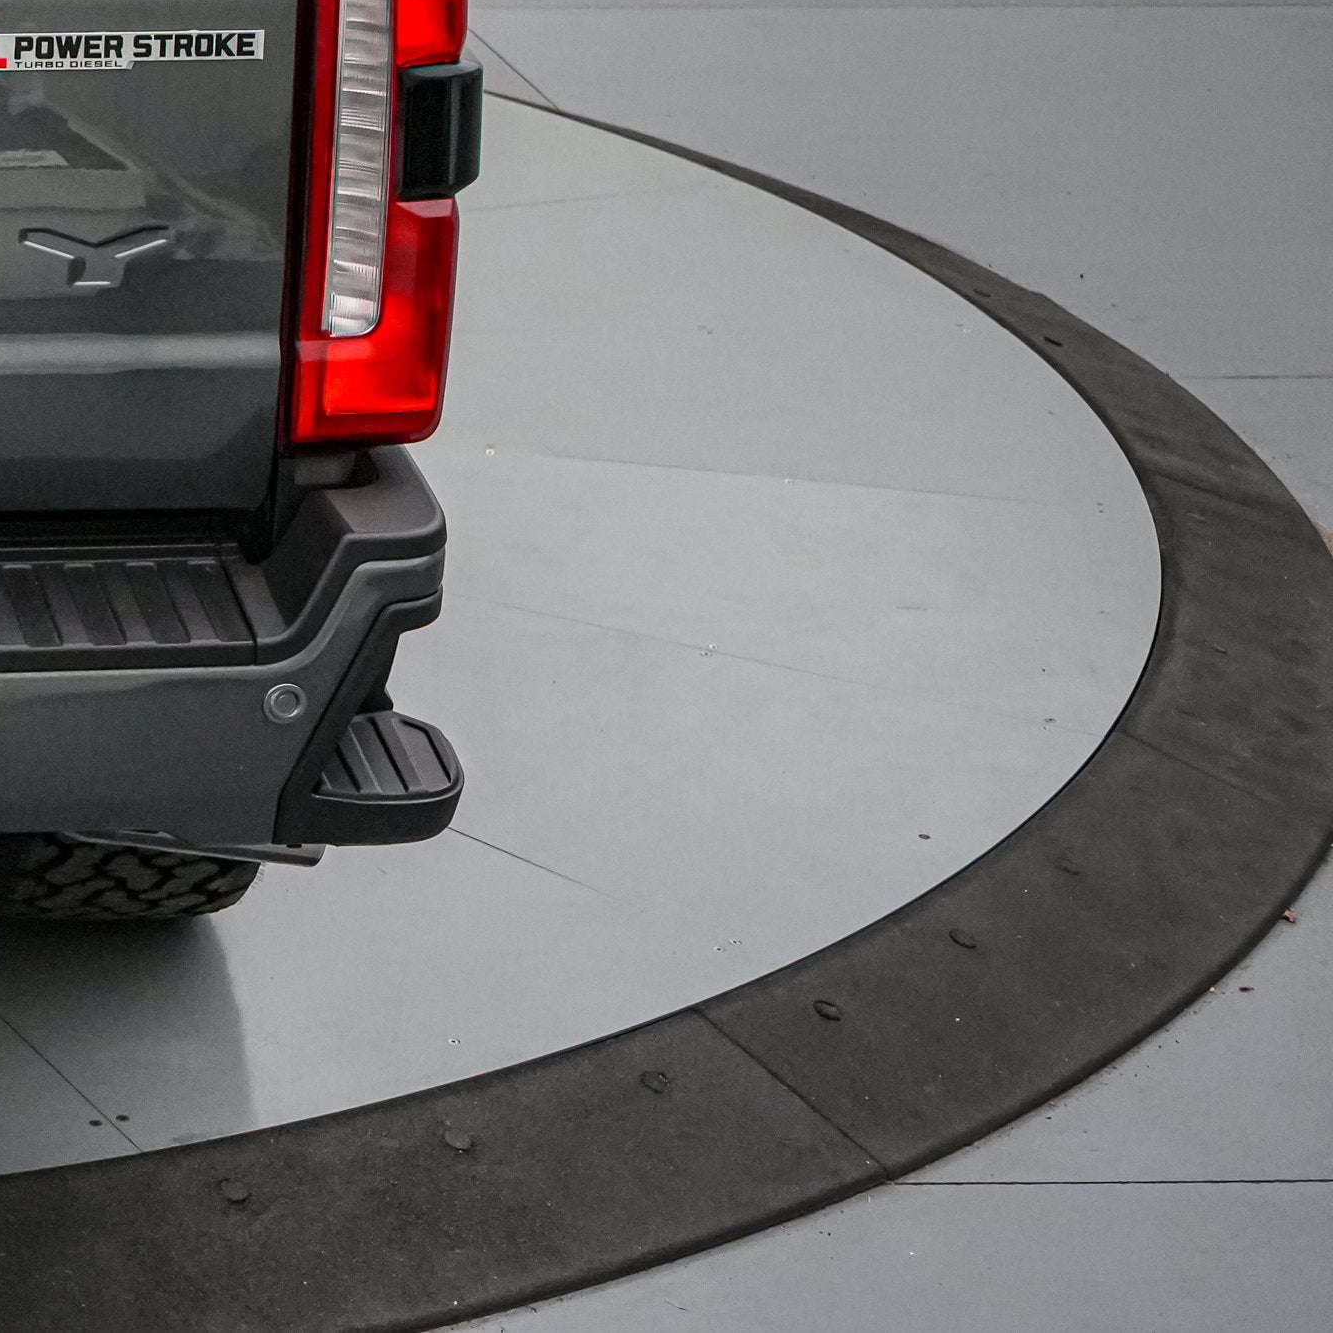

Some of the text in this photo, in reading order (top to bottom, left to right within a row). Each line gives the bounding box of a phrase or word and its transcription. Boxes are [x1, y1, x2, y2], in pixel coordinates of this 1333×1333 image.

[14, 35, 124, 60] POWER
[133, 32, 256, 58] STROKE
[14, 60, 123, 69] TURBO DIESEL
